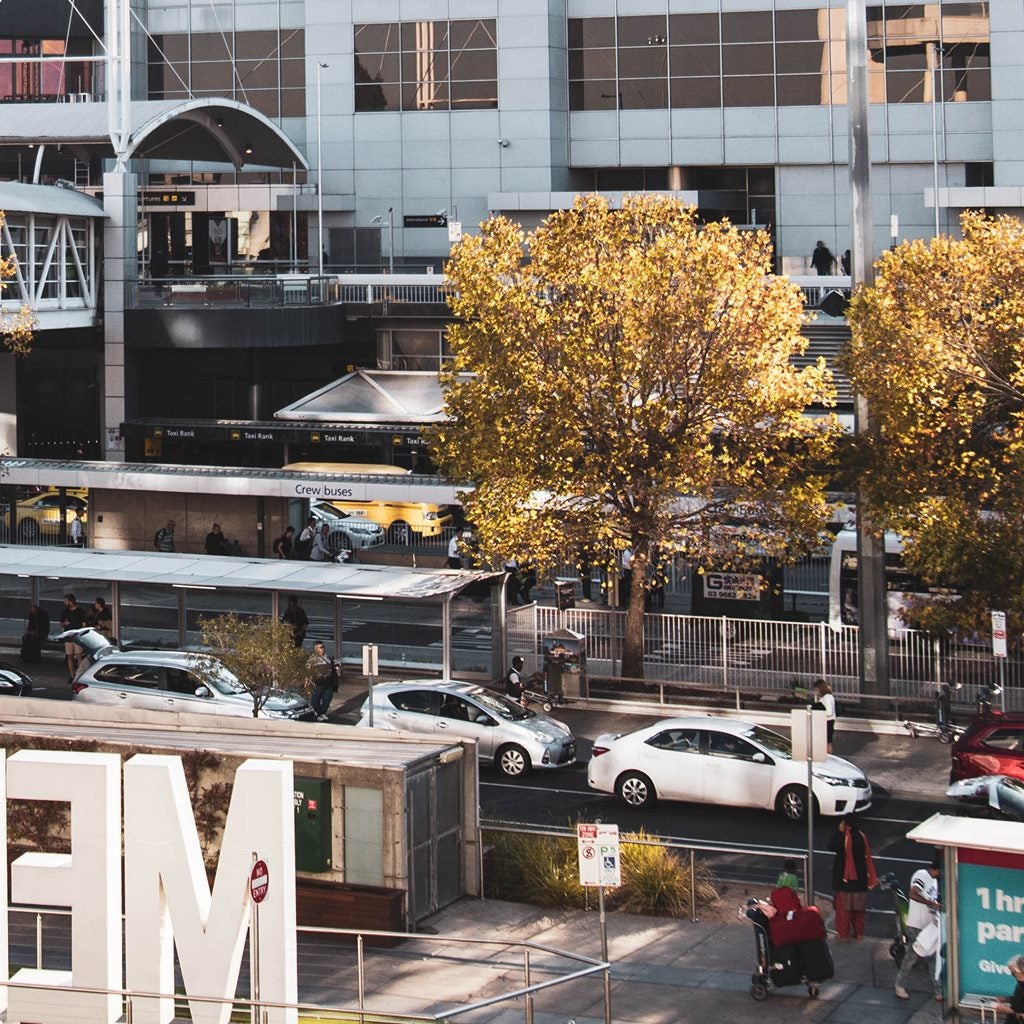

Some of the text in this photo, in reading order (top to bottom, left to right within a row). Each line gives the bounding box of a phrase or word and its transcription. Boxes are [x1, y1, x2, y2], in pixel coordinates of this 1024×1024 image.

[167, 429, 195, 438] Taxi Rank
[244, 431, 273, 440] Taxi Rank
[338, 435, 354, 443] Rank
[295, 484, 352, 497] Crew buses
[256, 867, 263, 877] NO
[253, 885, 267, 898] ENTRY
[976, 887, 990, 910] 1
